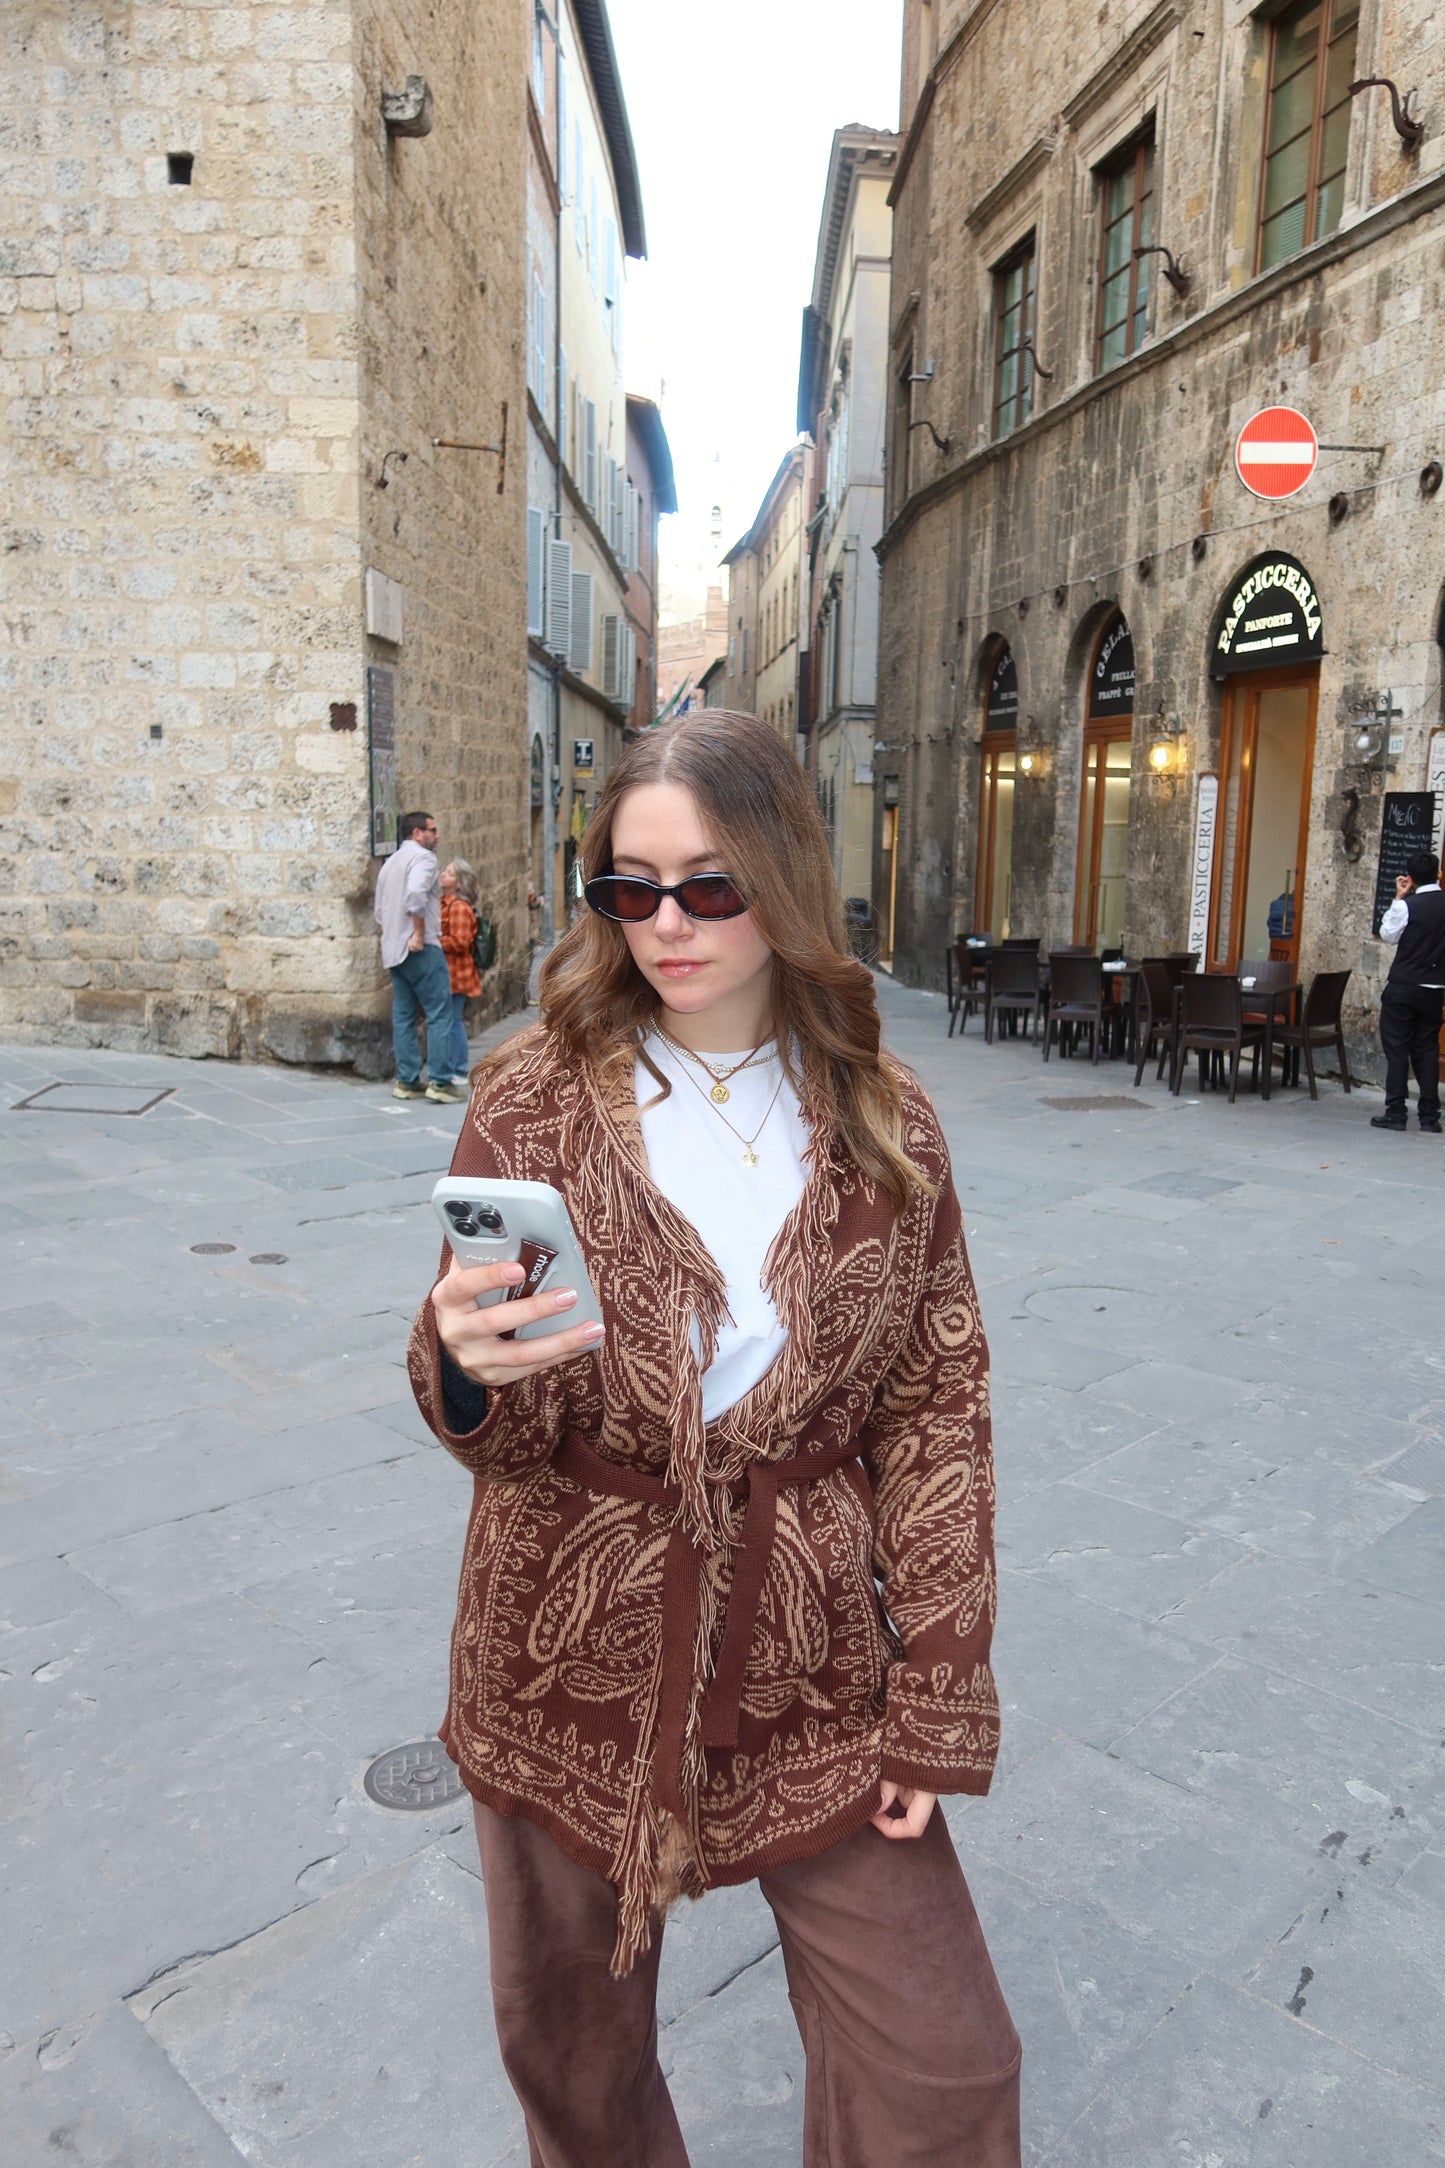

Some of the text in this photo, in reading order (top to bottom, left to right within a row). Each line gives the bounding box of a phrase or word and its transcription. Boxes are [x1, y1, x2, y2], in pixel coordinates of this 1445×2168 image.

[1217, 563, 1321, 654] PASTICCERIA
[1244, 612, 1293, 633] PANFORTE
[1111, 670, 1136, 682] FRULLA
[1429, 771, 1445, 854] WICHES
[1193, 807, 1214, 918] PASTICCERIA
[529, 1254, 549, 1282] rhode
